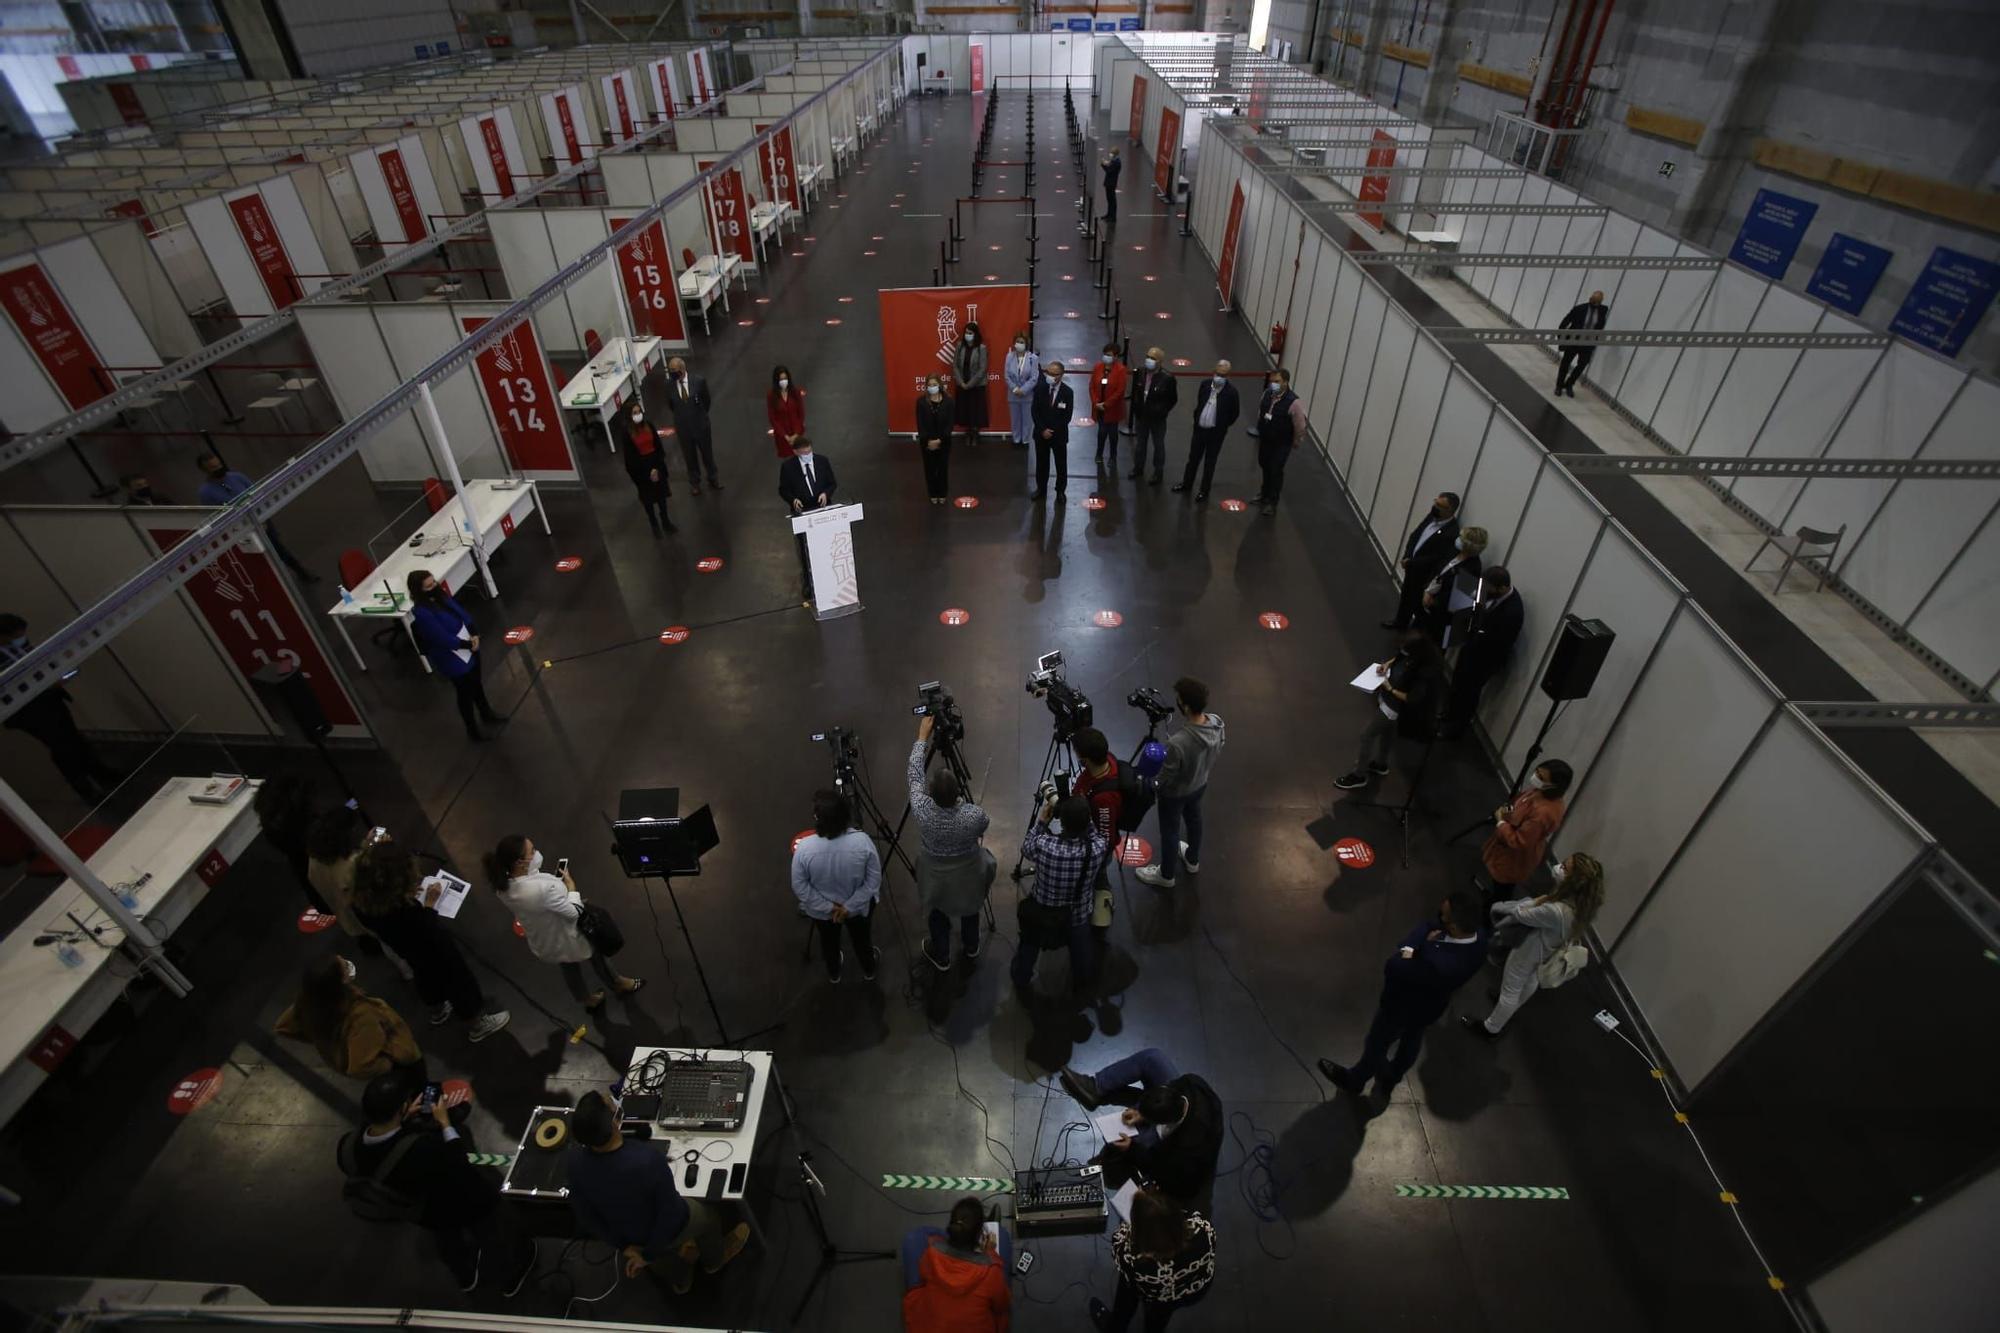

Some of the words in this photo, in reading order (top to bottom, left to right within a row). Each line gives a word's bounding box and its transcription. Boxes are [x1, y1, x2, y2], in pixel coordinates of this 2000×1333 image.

[768, 156, 785, 171] 9
[715, 200, 735, 216] 17
[719, 220, 740, 236] 18
[633, 265, 661, 285] 15
[638, 290, 666, 309] 16
[498, 378, 536, 403] 13
[508, 408, 546, 432] 14
[229, 609, 286, 640] 11
[204, 859, 222, 876] 12
[42, 1038, 64, 1058] 11
